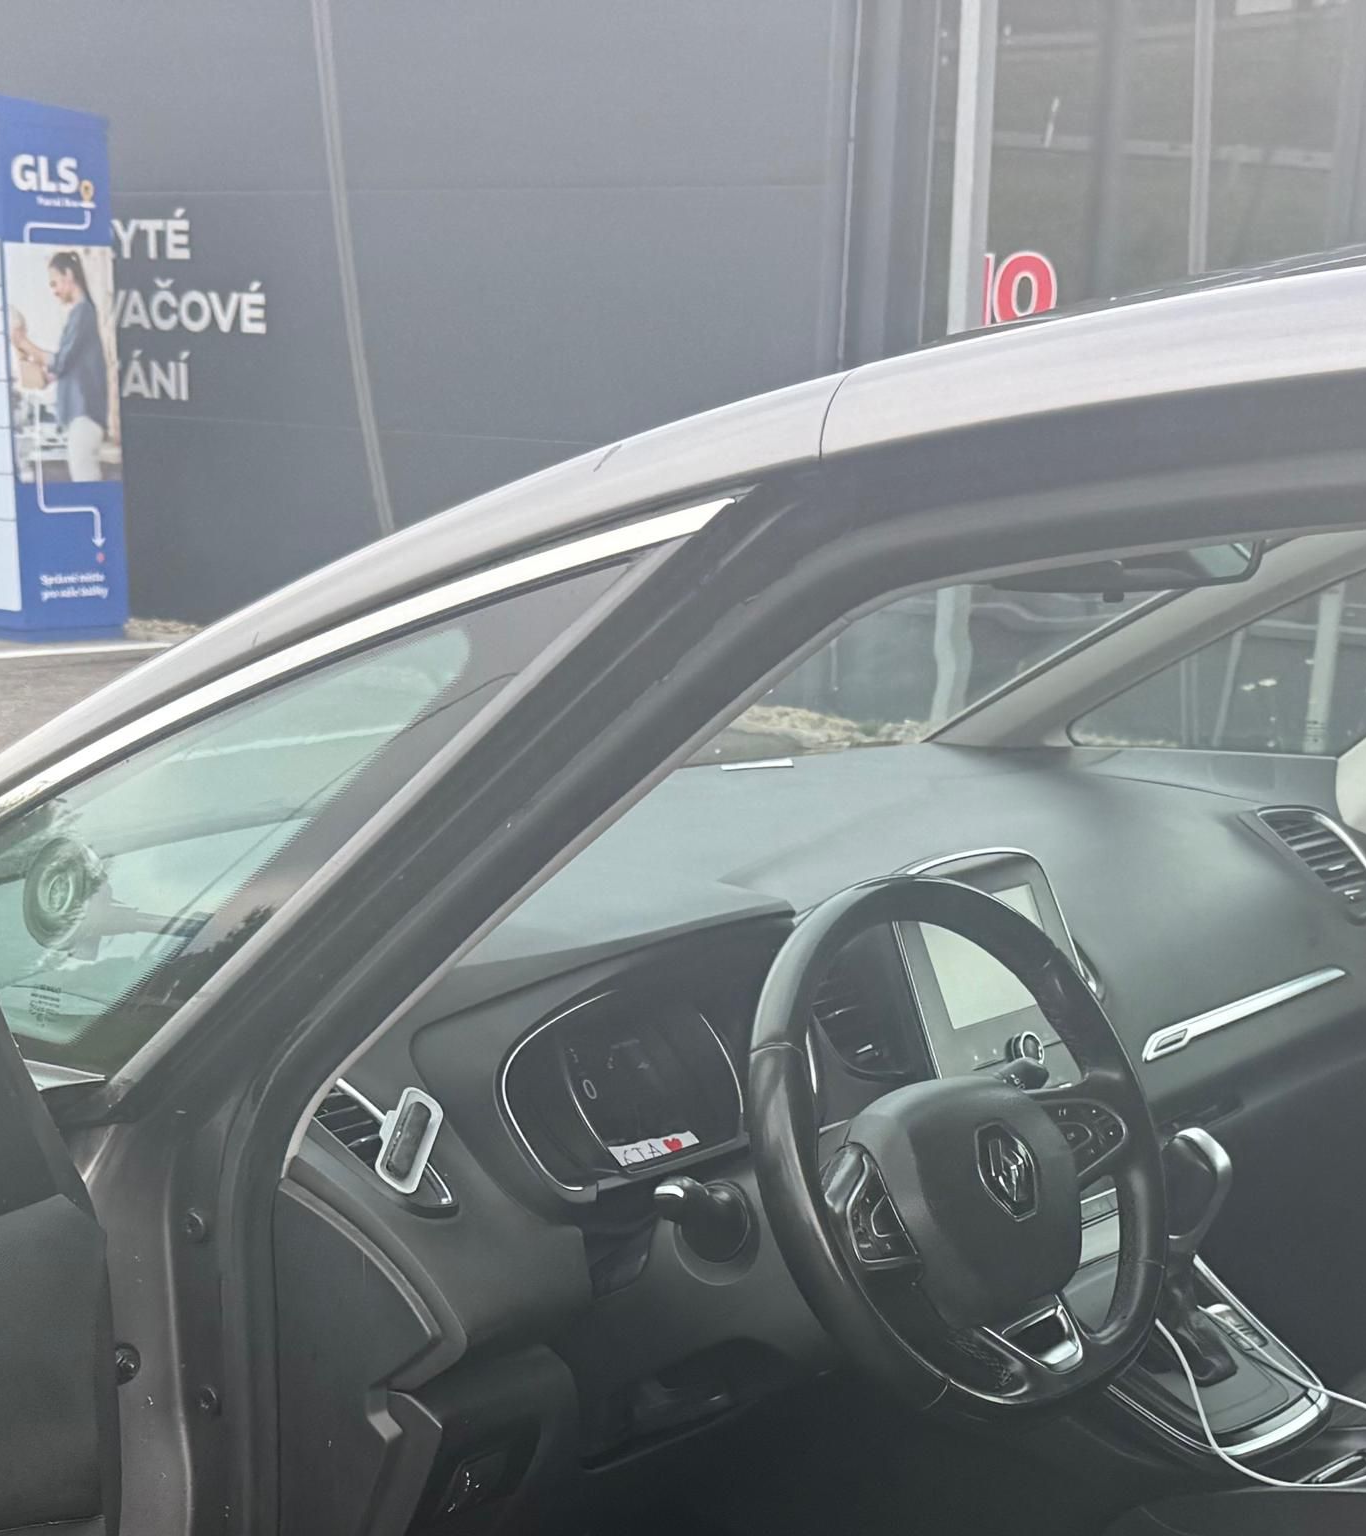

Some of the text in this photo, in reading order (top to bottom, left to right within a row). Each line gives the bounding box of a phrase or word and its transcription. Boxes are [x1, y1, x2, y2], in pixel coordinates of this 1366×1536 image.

[11, 153, 79, 194] GLS
[111, 207, 191, 260] YTÉ
[120, 349, 190, 401] ÁNÍ
